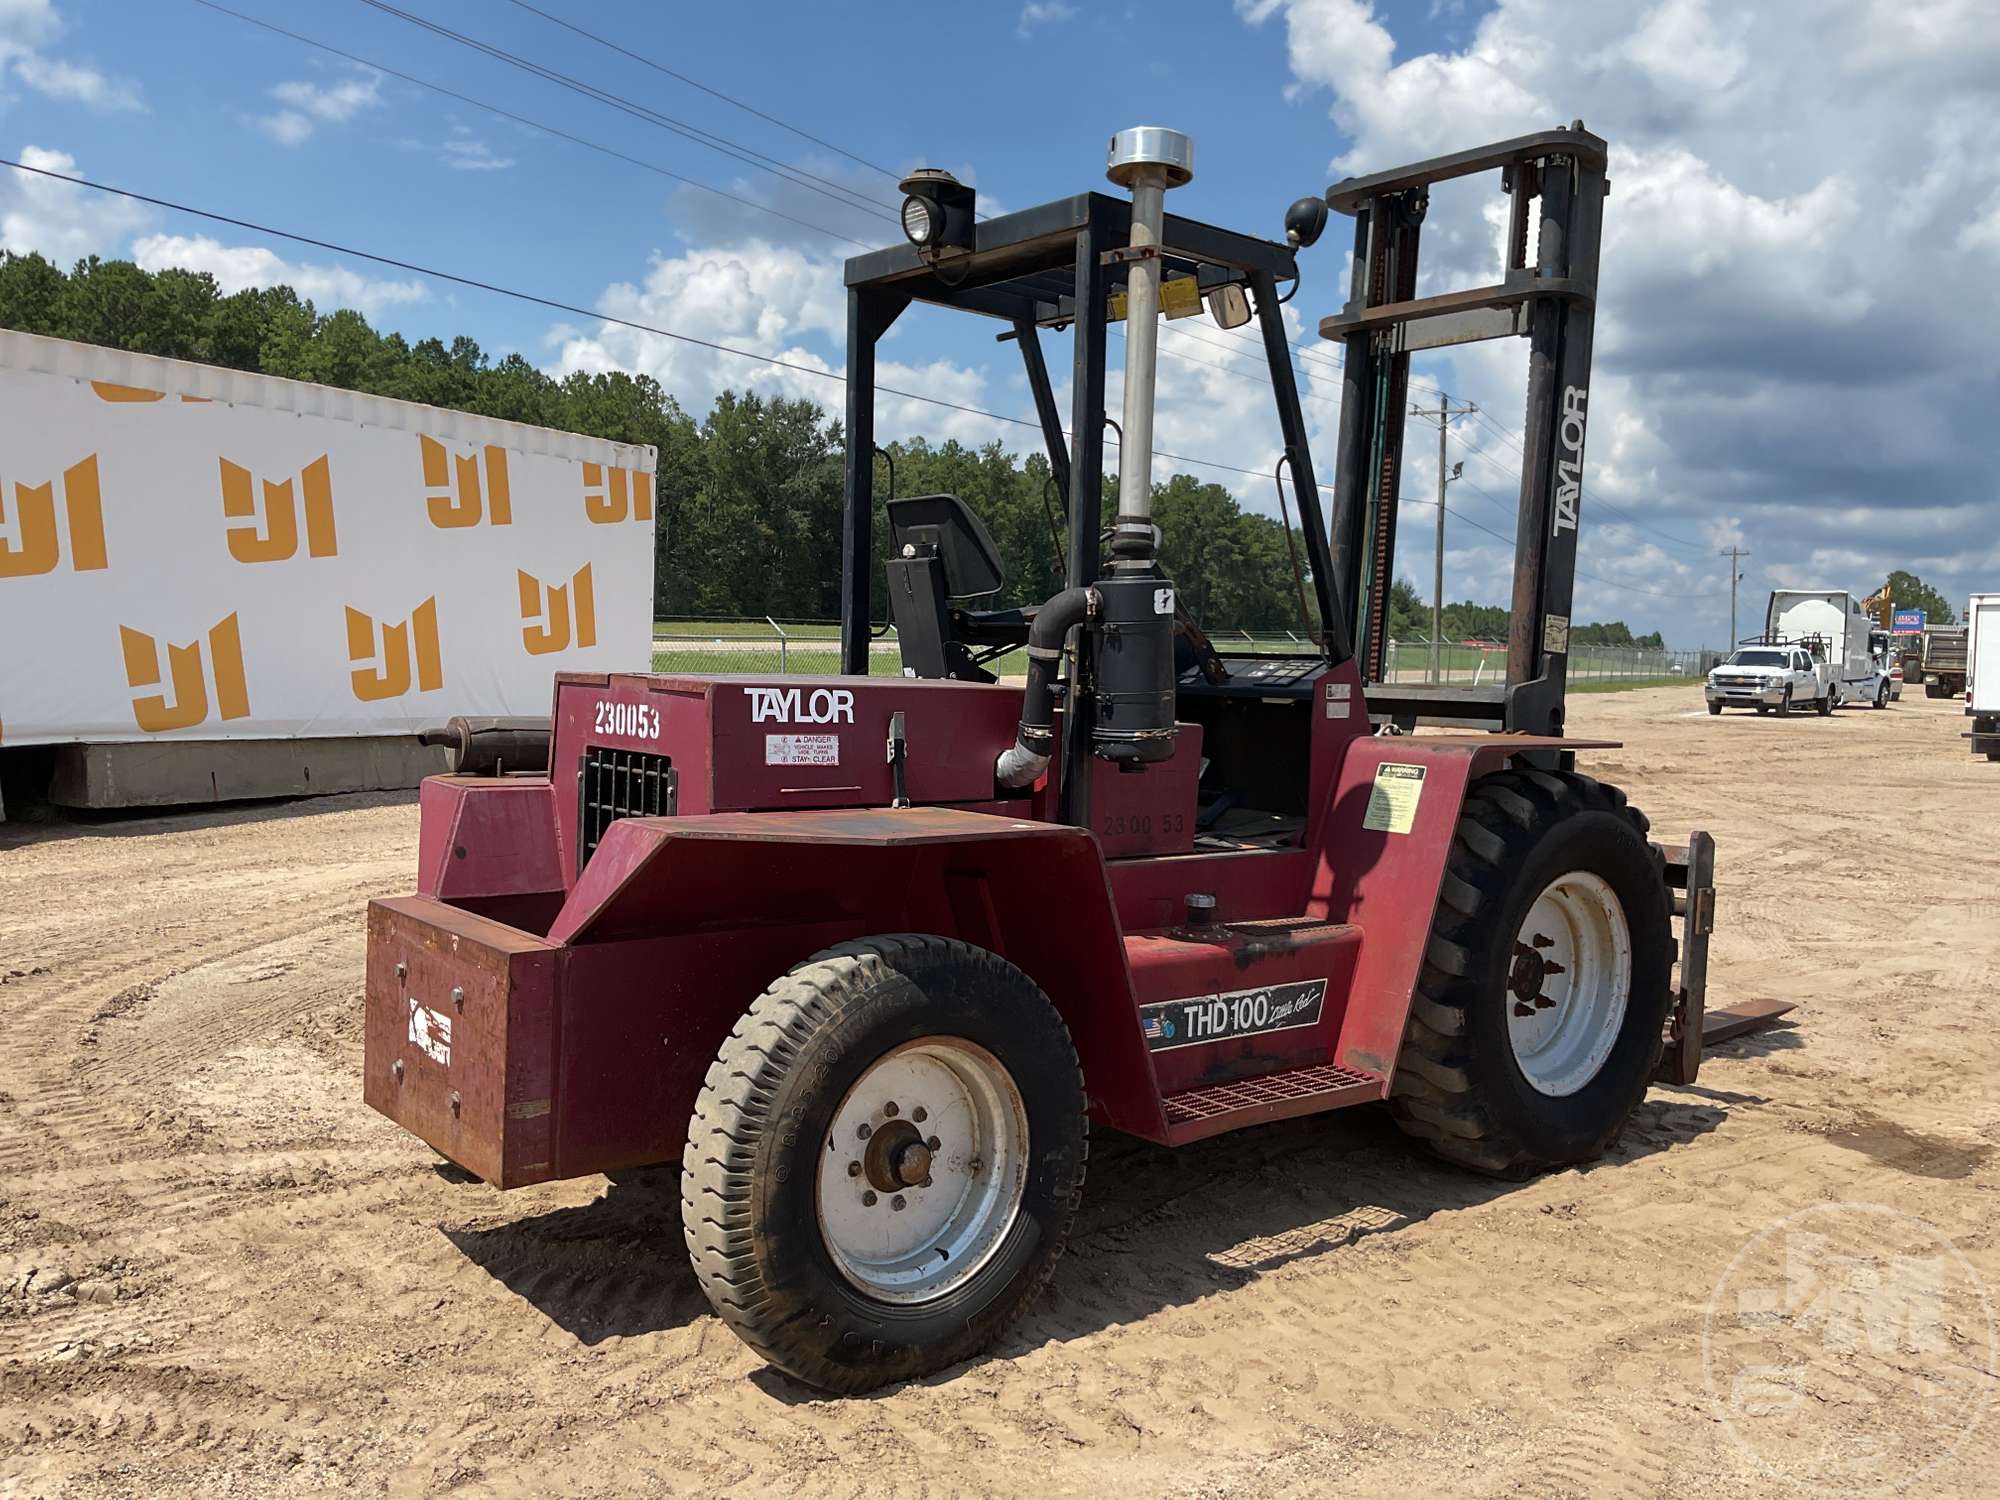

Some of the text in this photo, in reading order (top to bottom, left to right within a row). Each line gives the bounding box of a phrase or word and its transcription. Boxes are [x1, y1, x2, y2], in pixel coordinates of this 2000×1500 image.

[1553, 385, 1587, 537] TAYLOR
[595, 701, 660, 739] 230053
[744, 687, 855, 724] TAYLOR
